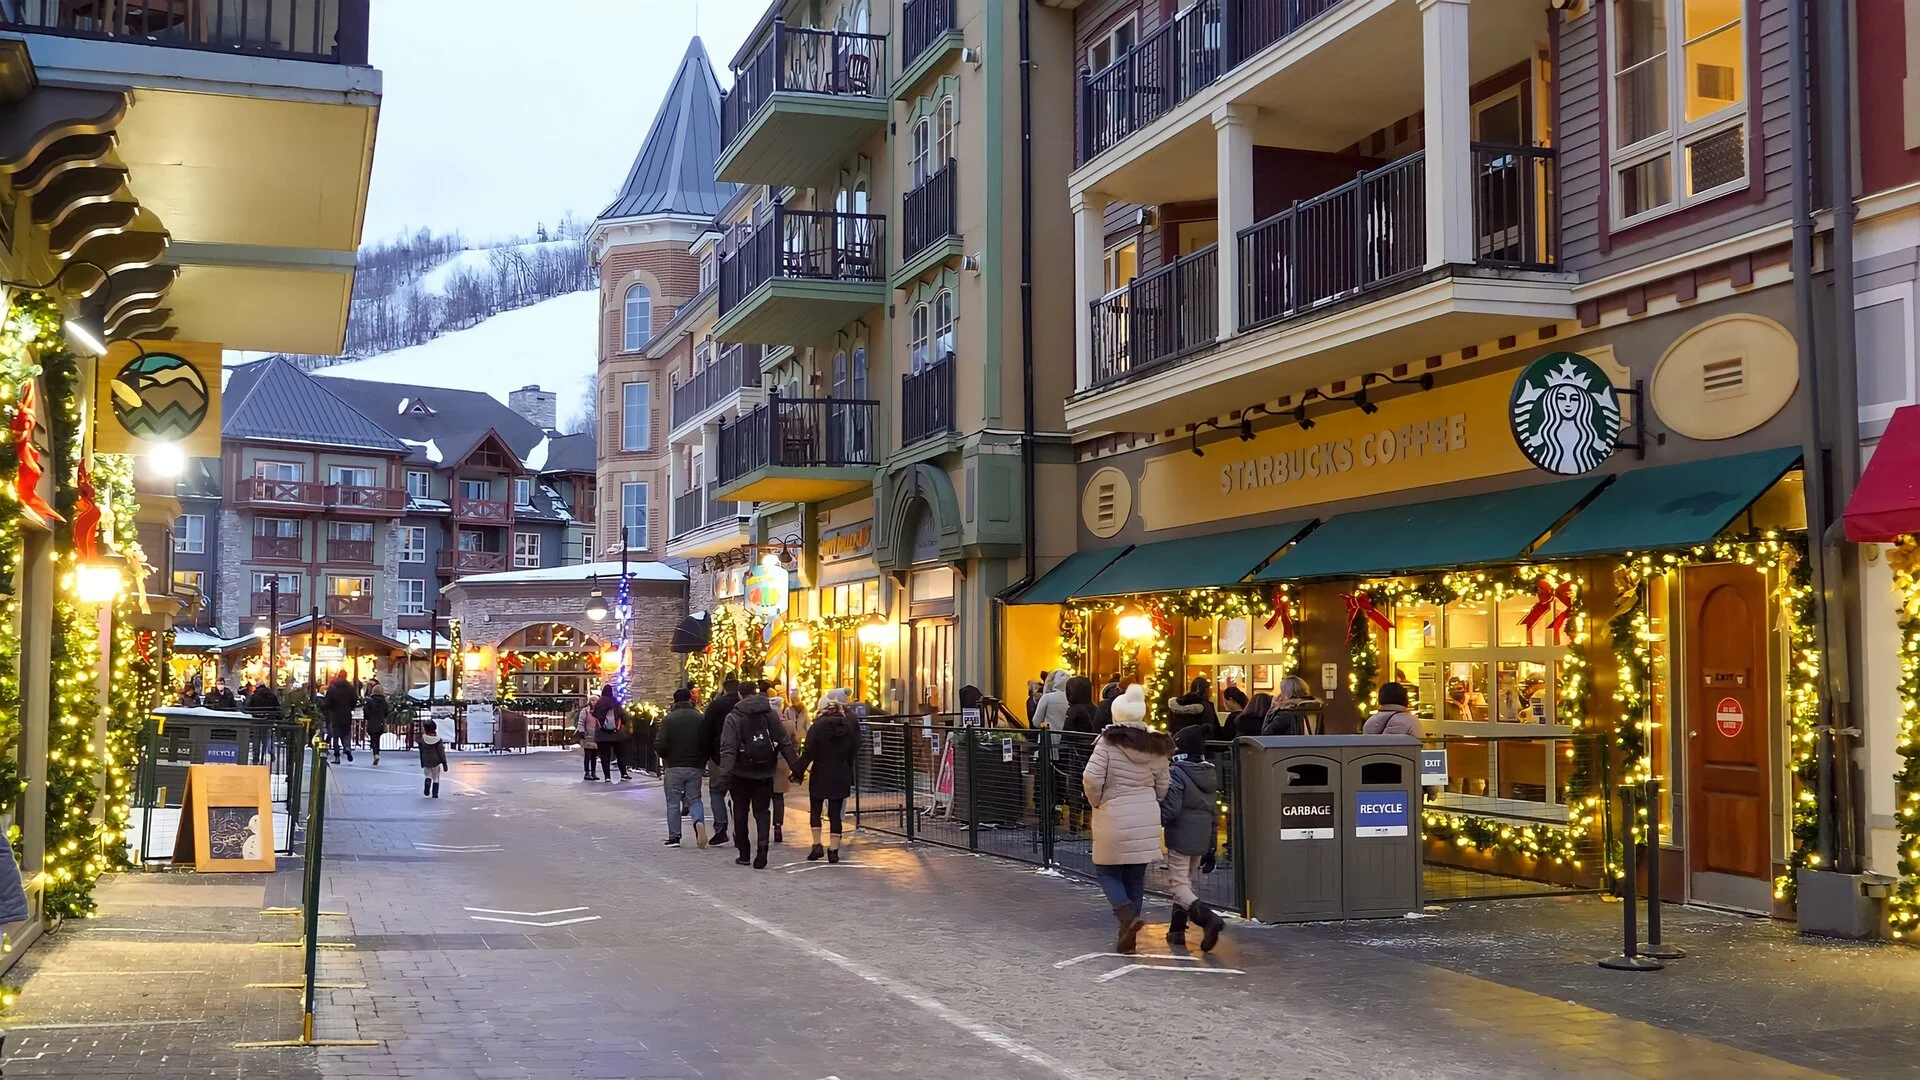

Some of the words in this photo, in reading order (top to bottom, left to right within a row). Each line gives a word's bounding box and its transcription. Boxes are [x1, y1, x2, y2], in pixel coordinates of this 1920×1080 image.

[1220, 438, 1354, 495] STARBUCKS
[1360, 412, 1467, 468] COFFEE
[159, 747, 191, 755] GAAGE
[1424, 759, 1441, 767] EXIT
[1282, 805, 1331, 816] GARBAGE
[1360, 803, 1403, 814] RECYCLE
